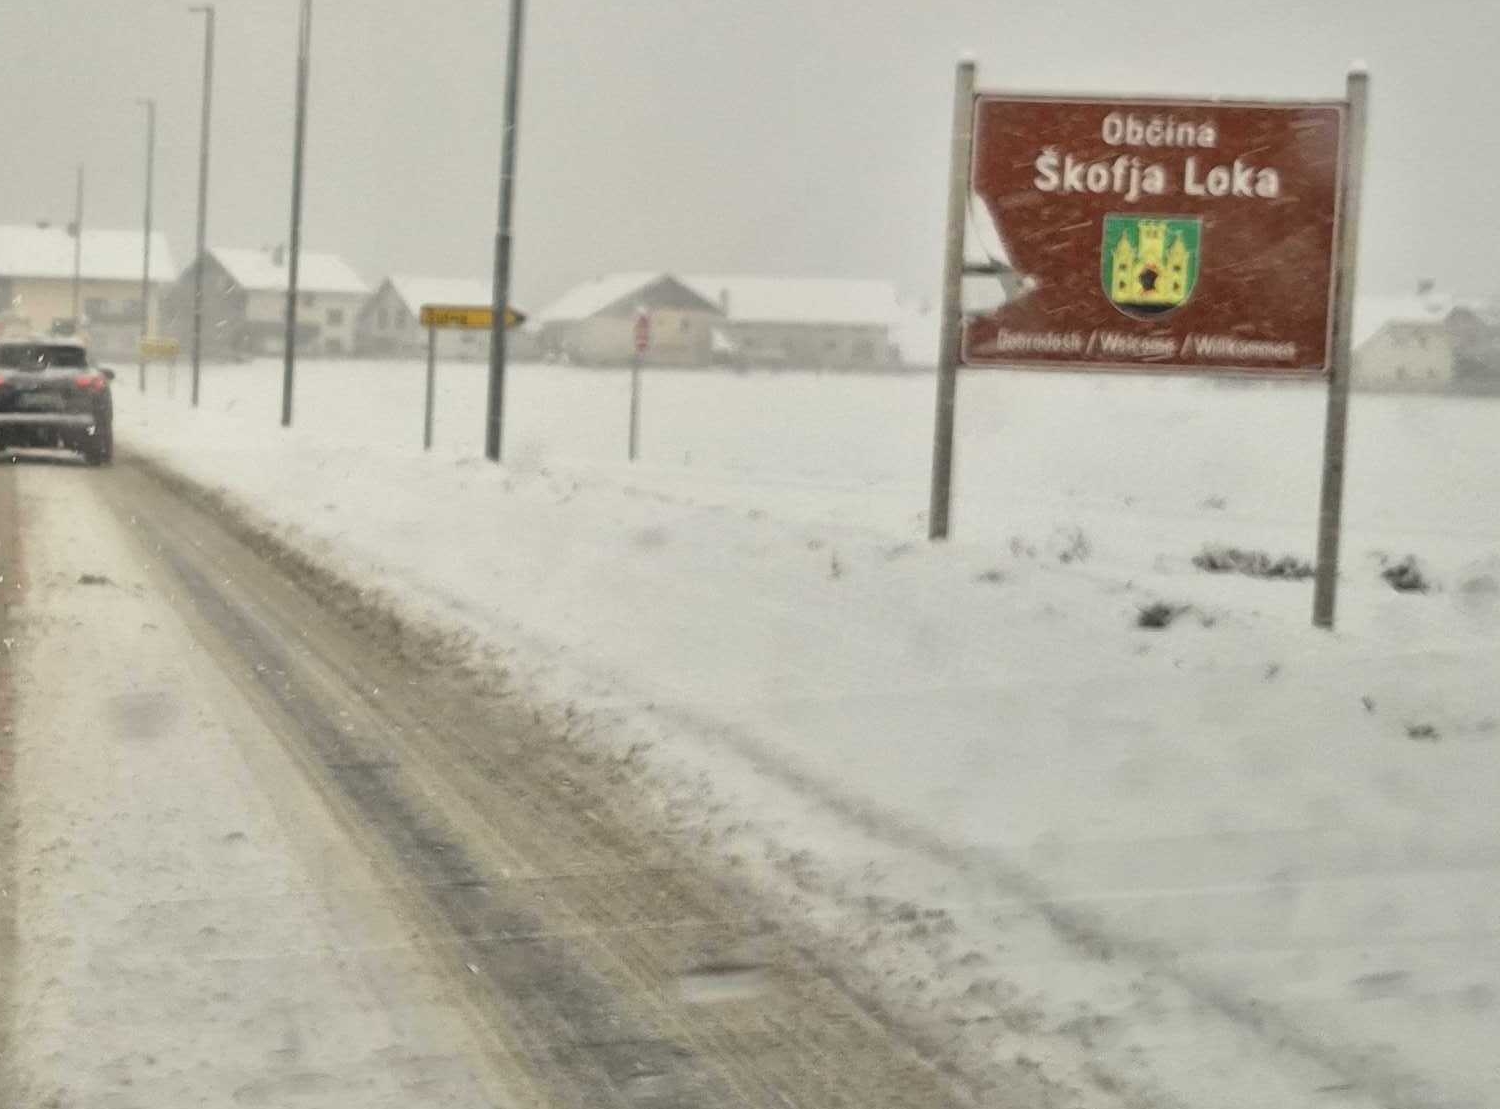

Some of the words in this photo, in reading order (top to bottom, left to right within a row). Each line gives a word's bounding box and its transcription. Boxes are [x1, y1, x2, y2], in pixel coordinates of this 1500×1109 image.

[1102, 111, 1217, 148] Občina
[1033, 144, 1165, 202] Škofja
[1184, 156, 1279, 198] Loka
